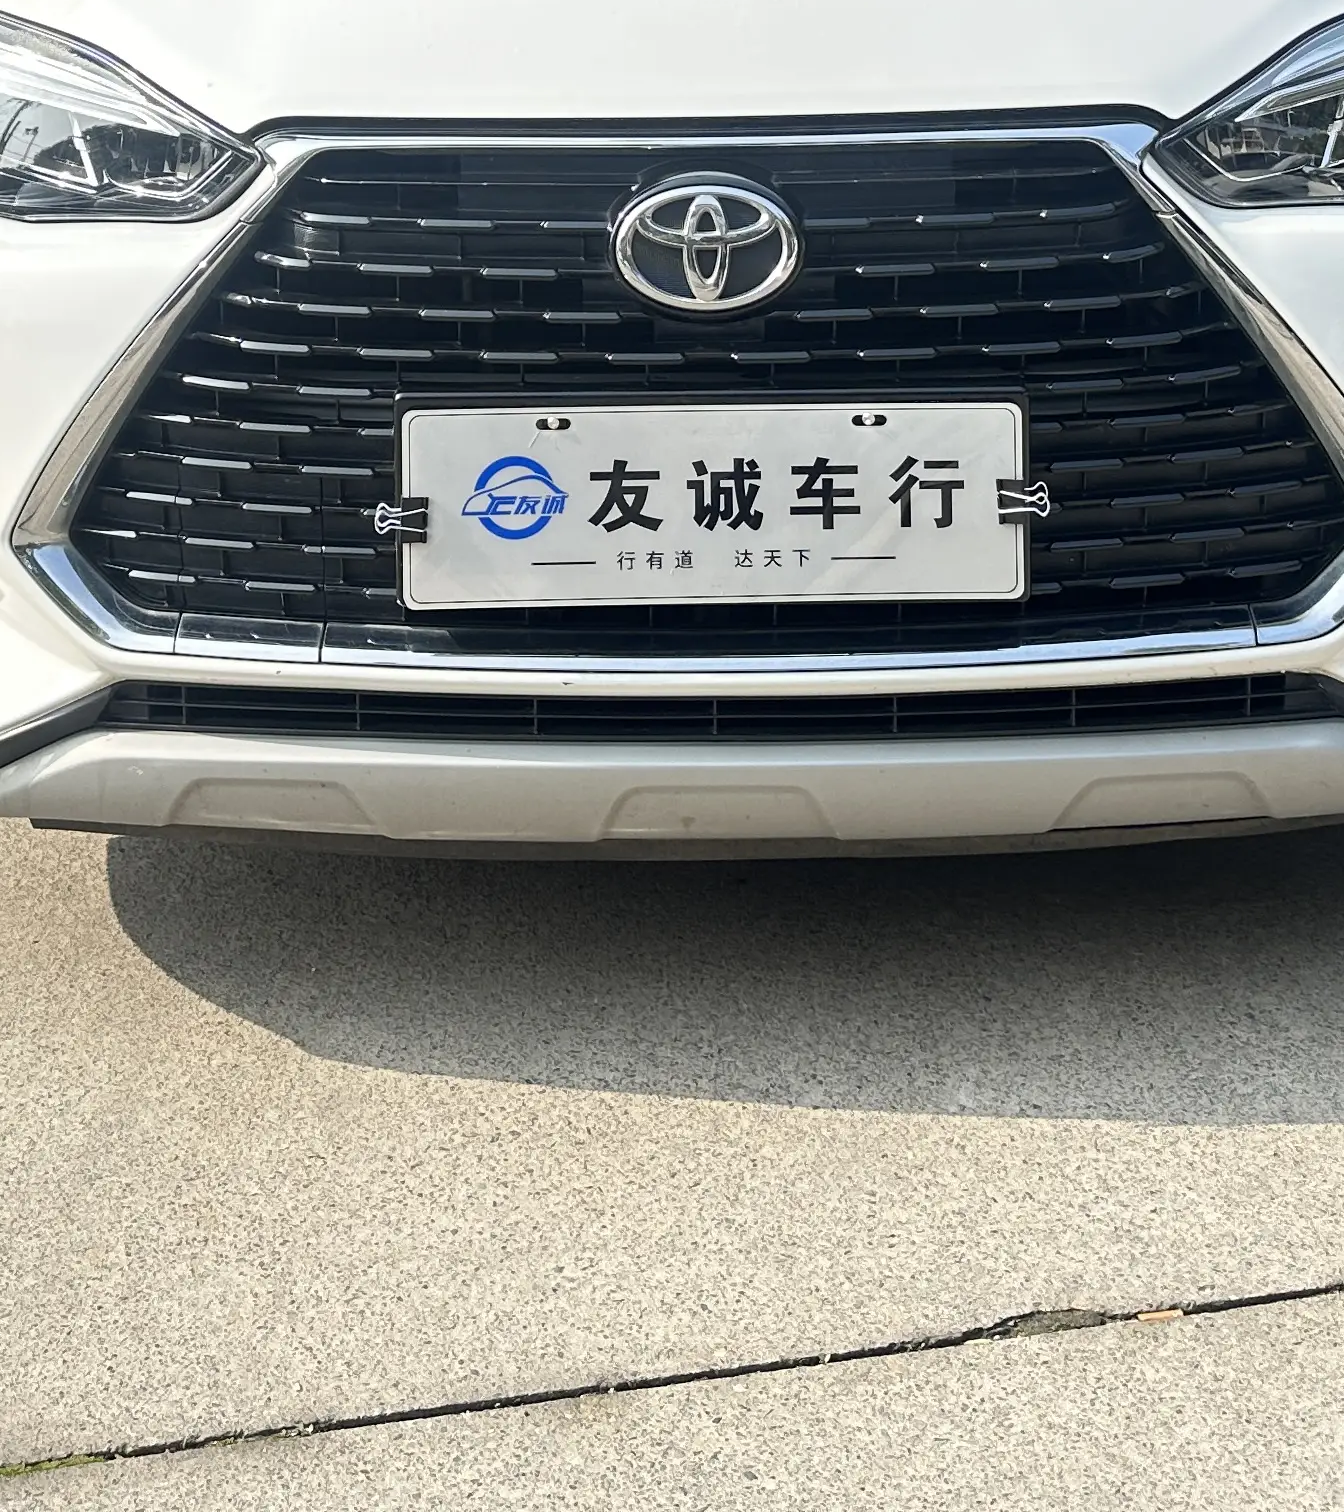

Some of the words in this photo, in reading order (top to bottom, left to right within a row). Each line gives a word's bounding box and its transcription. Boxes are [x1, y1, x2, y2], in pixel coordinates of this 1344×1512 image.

[588, 454, 967, 533] 友诚车行
[616, 550, 694, 571] 行有道
[734, 548, 811, 569] 达天下
